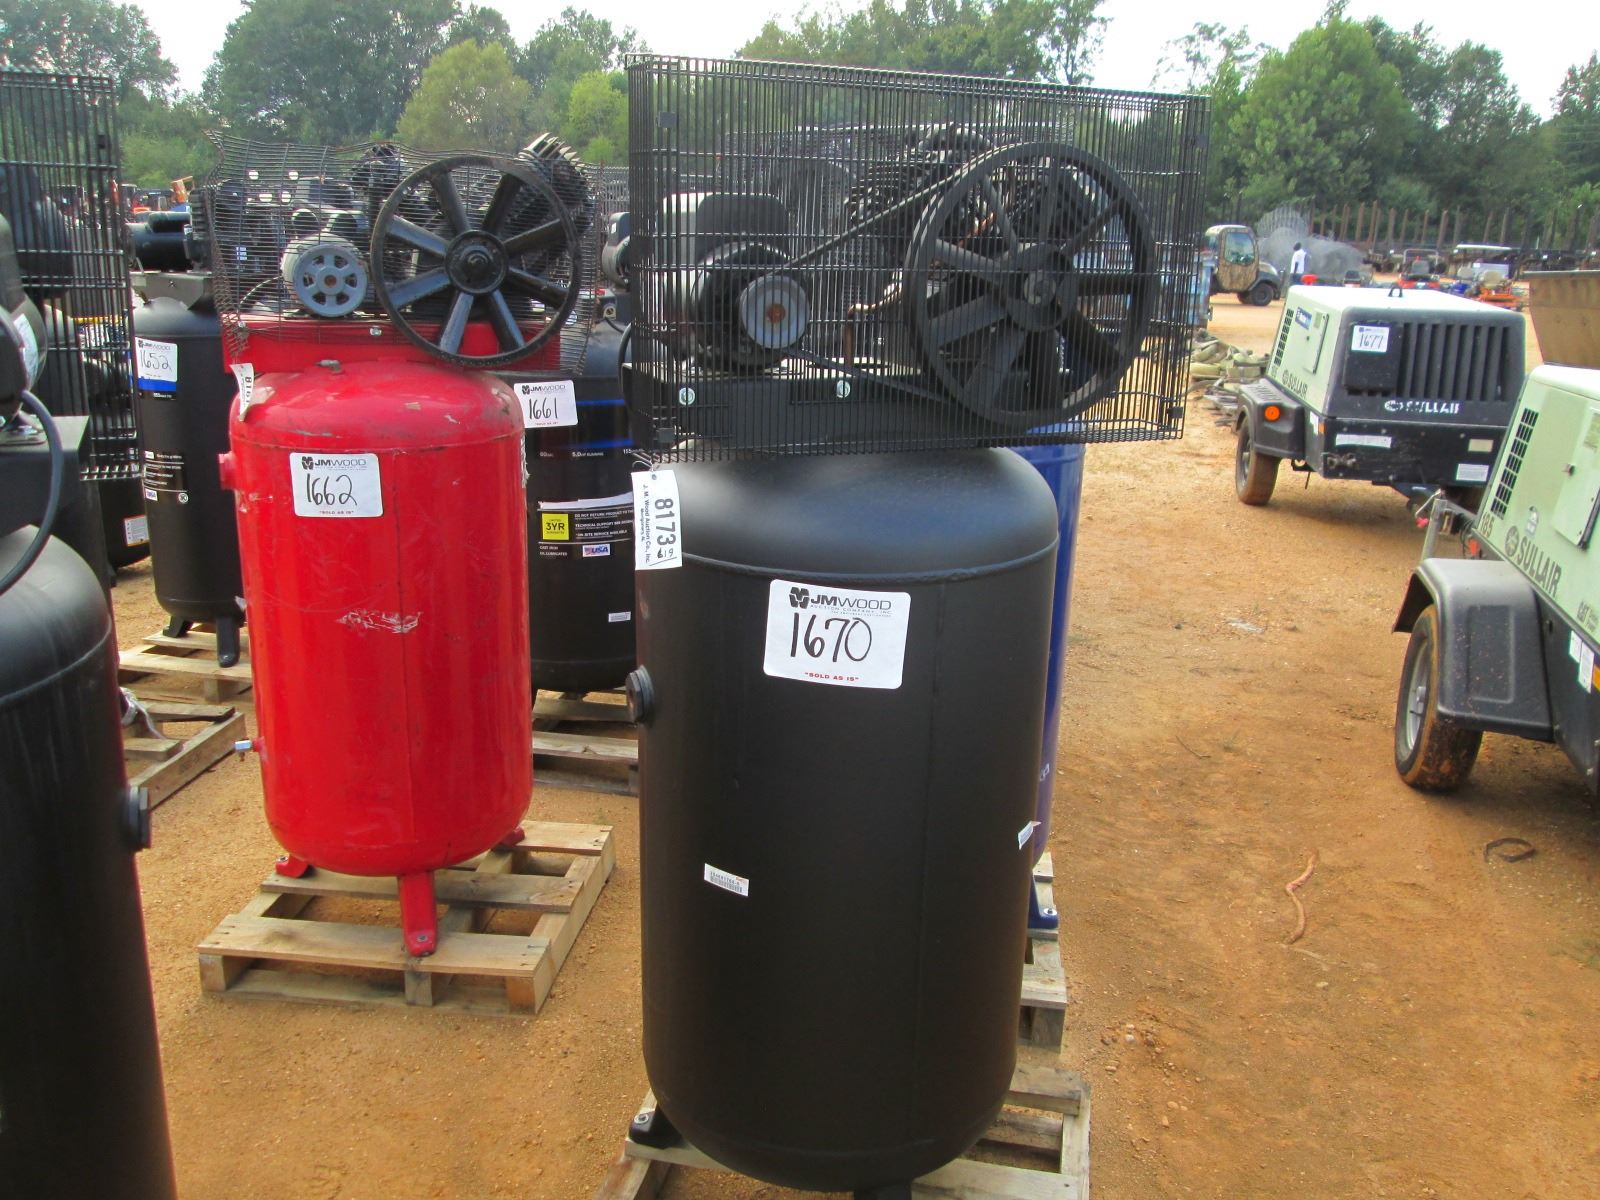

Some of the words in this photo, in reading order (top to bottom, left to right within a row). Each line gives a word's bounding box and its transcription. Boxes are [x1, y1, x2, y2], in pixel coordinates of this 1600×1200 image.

[1360, 333, 1384, 349] 1677
[140, 350, 172, 372] 1652
[529, 397, 558, 420] 1661
[314, 459, 367, 467] JMWOOD
[306, 473, 358, 506] 1662
[545, 522, 565, 531] 3YR
[654, 497, 677, 546] 8173
[1480, 512, 1495, 539] 185
[1517, 535, 1562, 598] SULLAIR
[810, 594, 892, 610] JMWOOD
[810, 604, 840, 612] AUCTION
[790, 612, 872, 662] 1670
